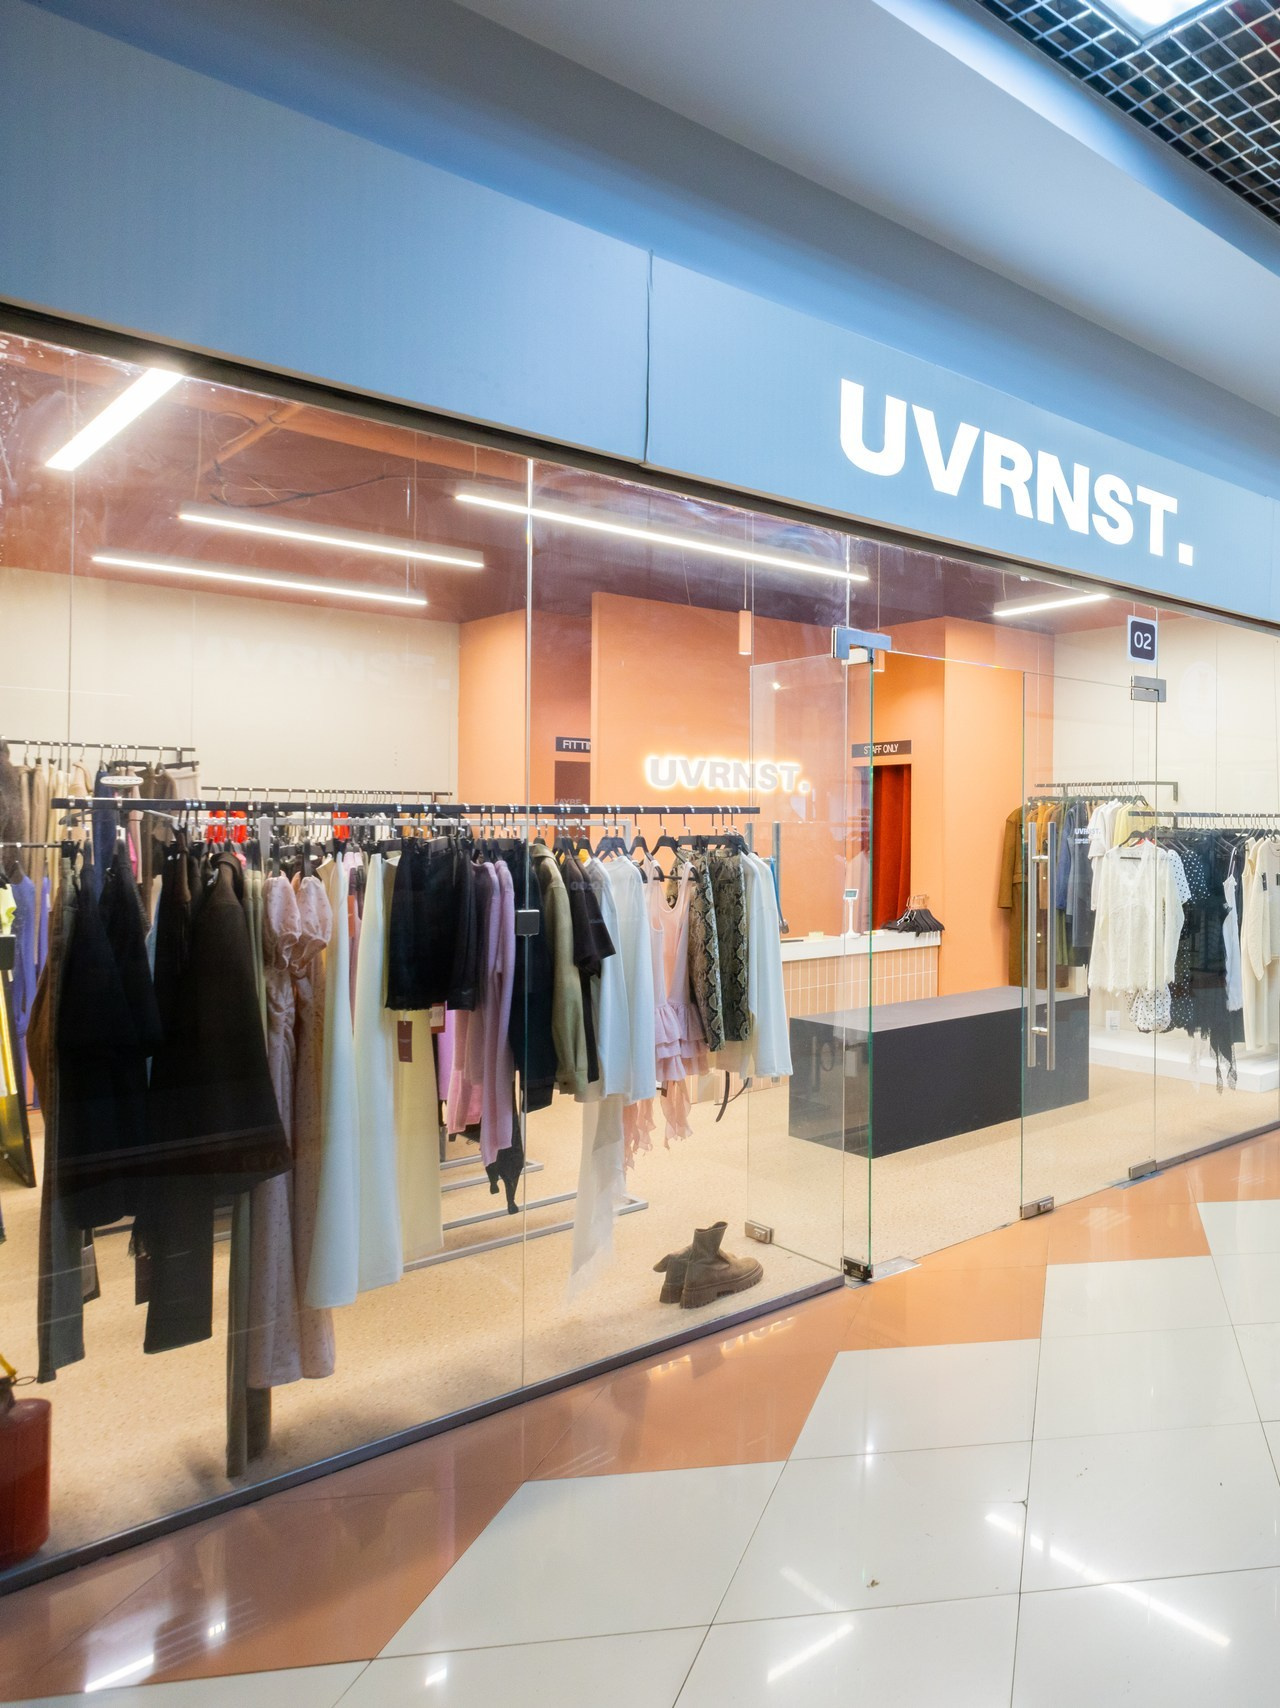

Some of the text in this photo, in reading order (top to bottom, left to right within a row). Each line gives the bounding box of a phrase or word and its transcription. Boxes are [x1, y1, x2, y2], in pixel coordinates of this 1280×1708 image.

[840, 378, 1194, 567] UVRNST.
[1133, 631, 1152, 650] 02
[883, 743, 899, 754] ONLY
[649, 757, 811, 793] UVRNST.
